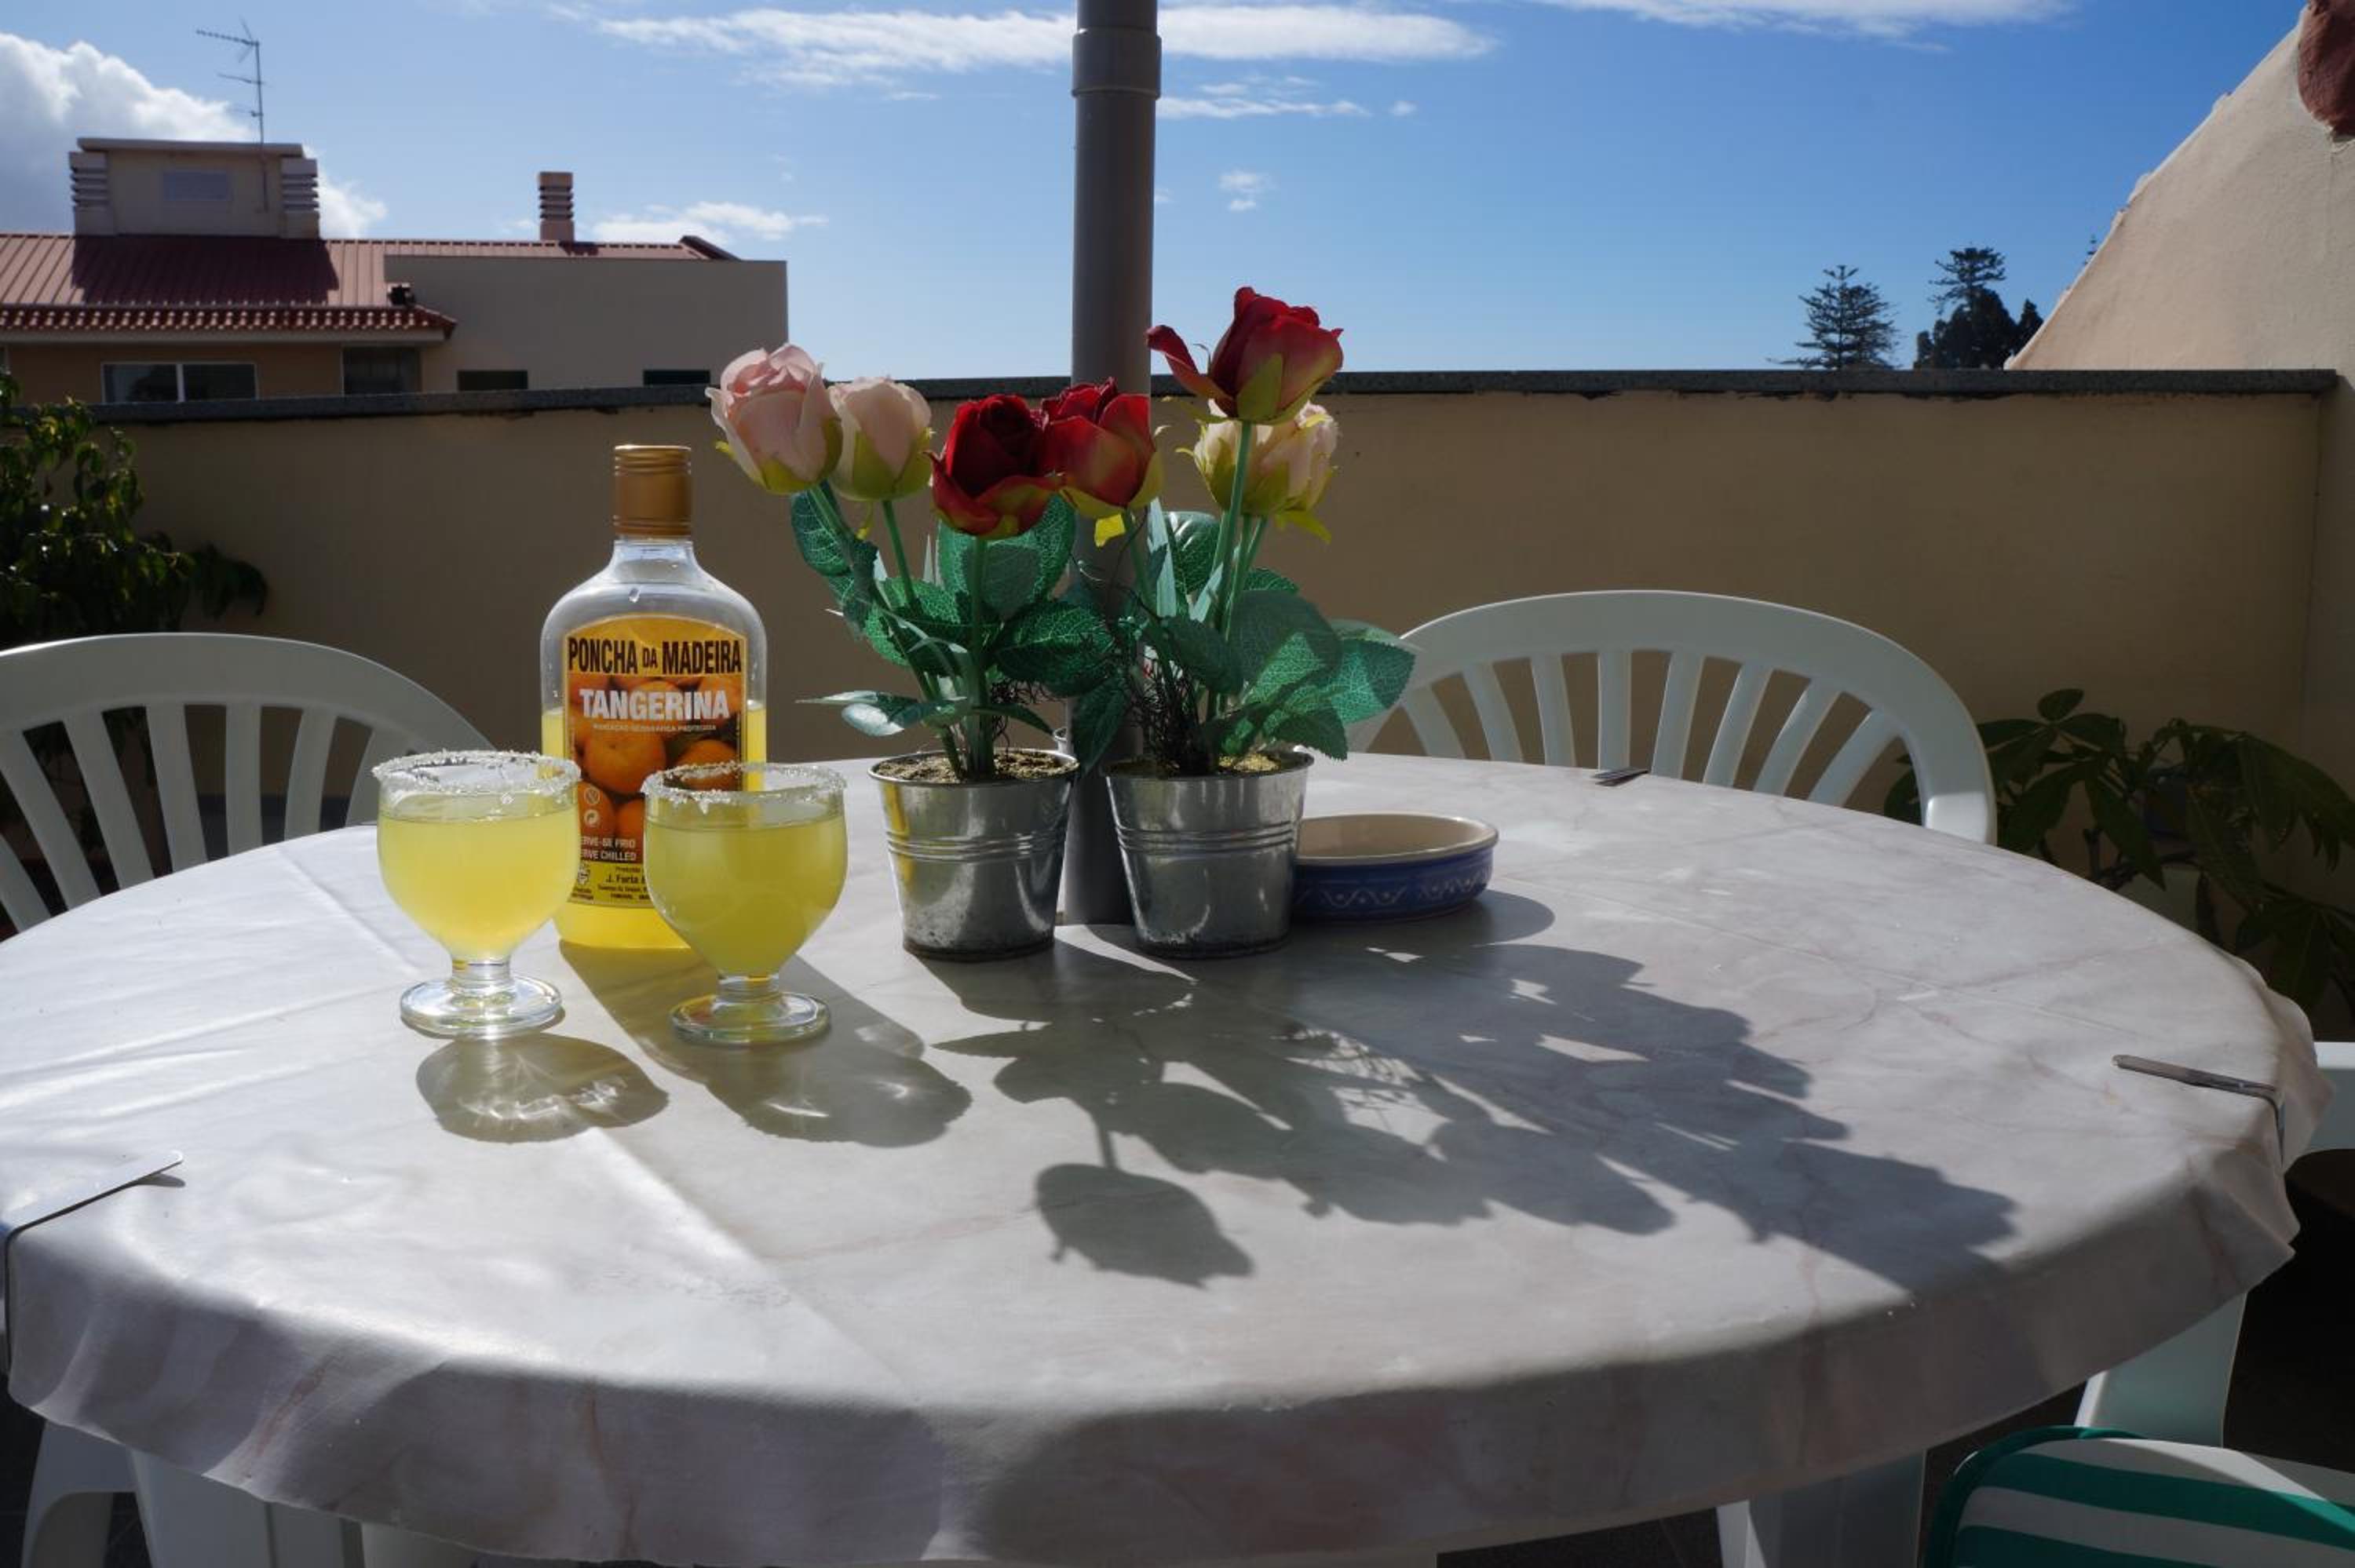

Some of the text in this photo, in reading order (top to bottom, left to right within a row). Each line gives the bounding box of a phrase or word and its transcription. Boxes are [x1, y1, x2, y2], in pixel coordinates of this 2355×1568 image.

[568, 637, 741, 673] PONCHA DA MADEIRA
[579, 689, 729, 720] TANGERINA
[580, 837, 635, 848] ERVE-SE FRIO
[580, 848, 637, 861] ERVE CHILLED
